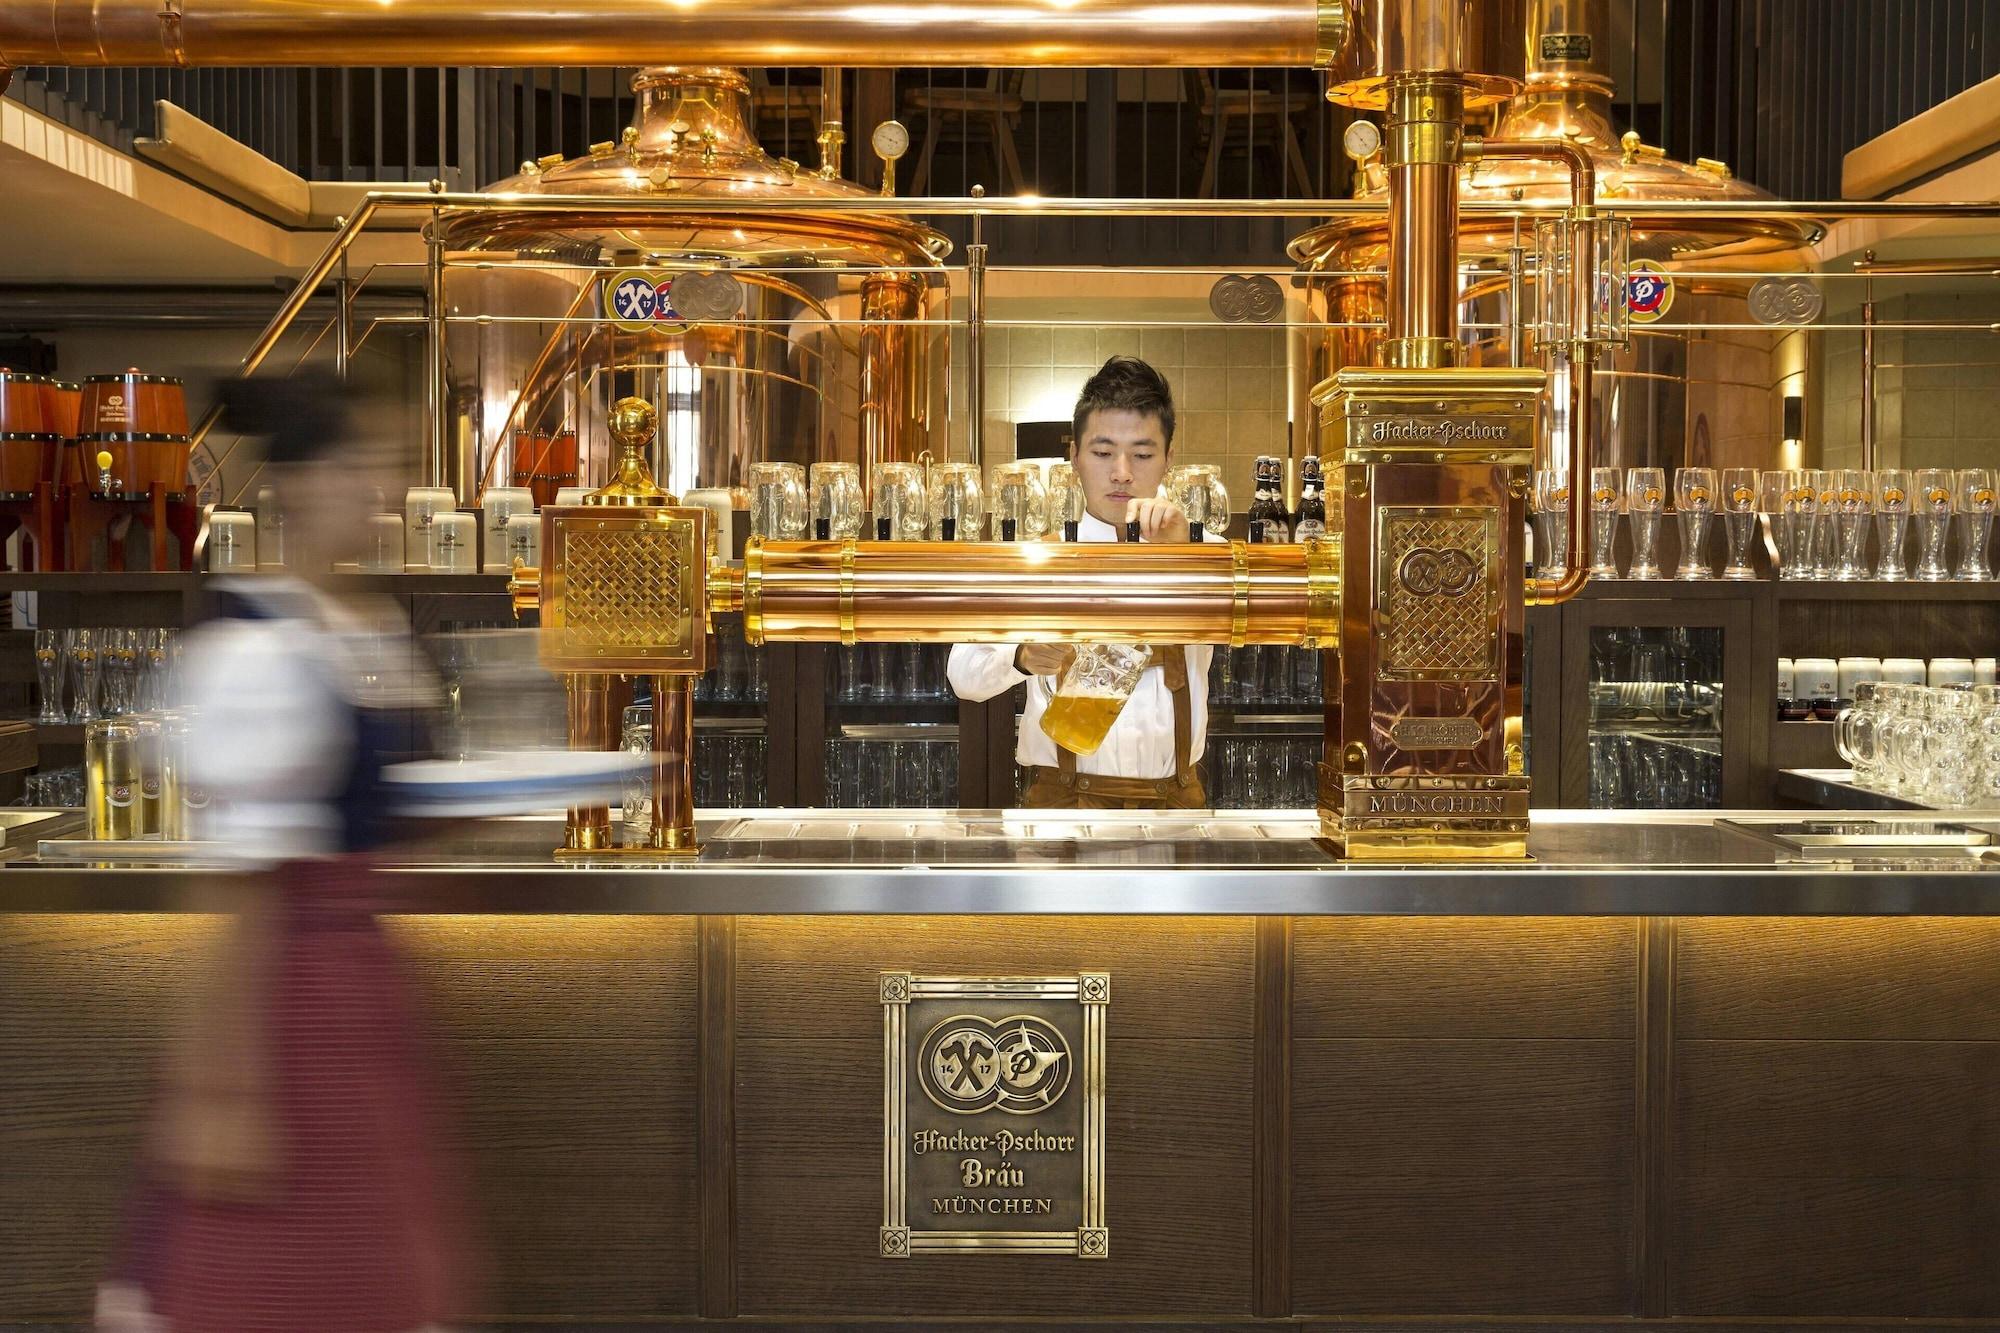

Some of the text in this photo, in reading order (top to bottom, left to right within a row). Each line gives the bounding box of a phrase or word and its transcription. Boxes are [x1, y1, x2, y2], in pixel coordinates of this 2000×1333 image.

[618, 298, 652, 308] 14 17
[1372, 419, 1507, 446] Hacker-Pschorr
[1370, 792, 1504, 813] MÜNCHEN
[940, 1064, 992, 1074] 14 17
[913, 1128, 1075, 1157] Hacker-Pschorr
[959, 1158, 1025, 1188] Bräu
[932, 1195, 1053, 1214] MÜNCHEN
